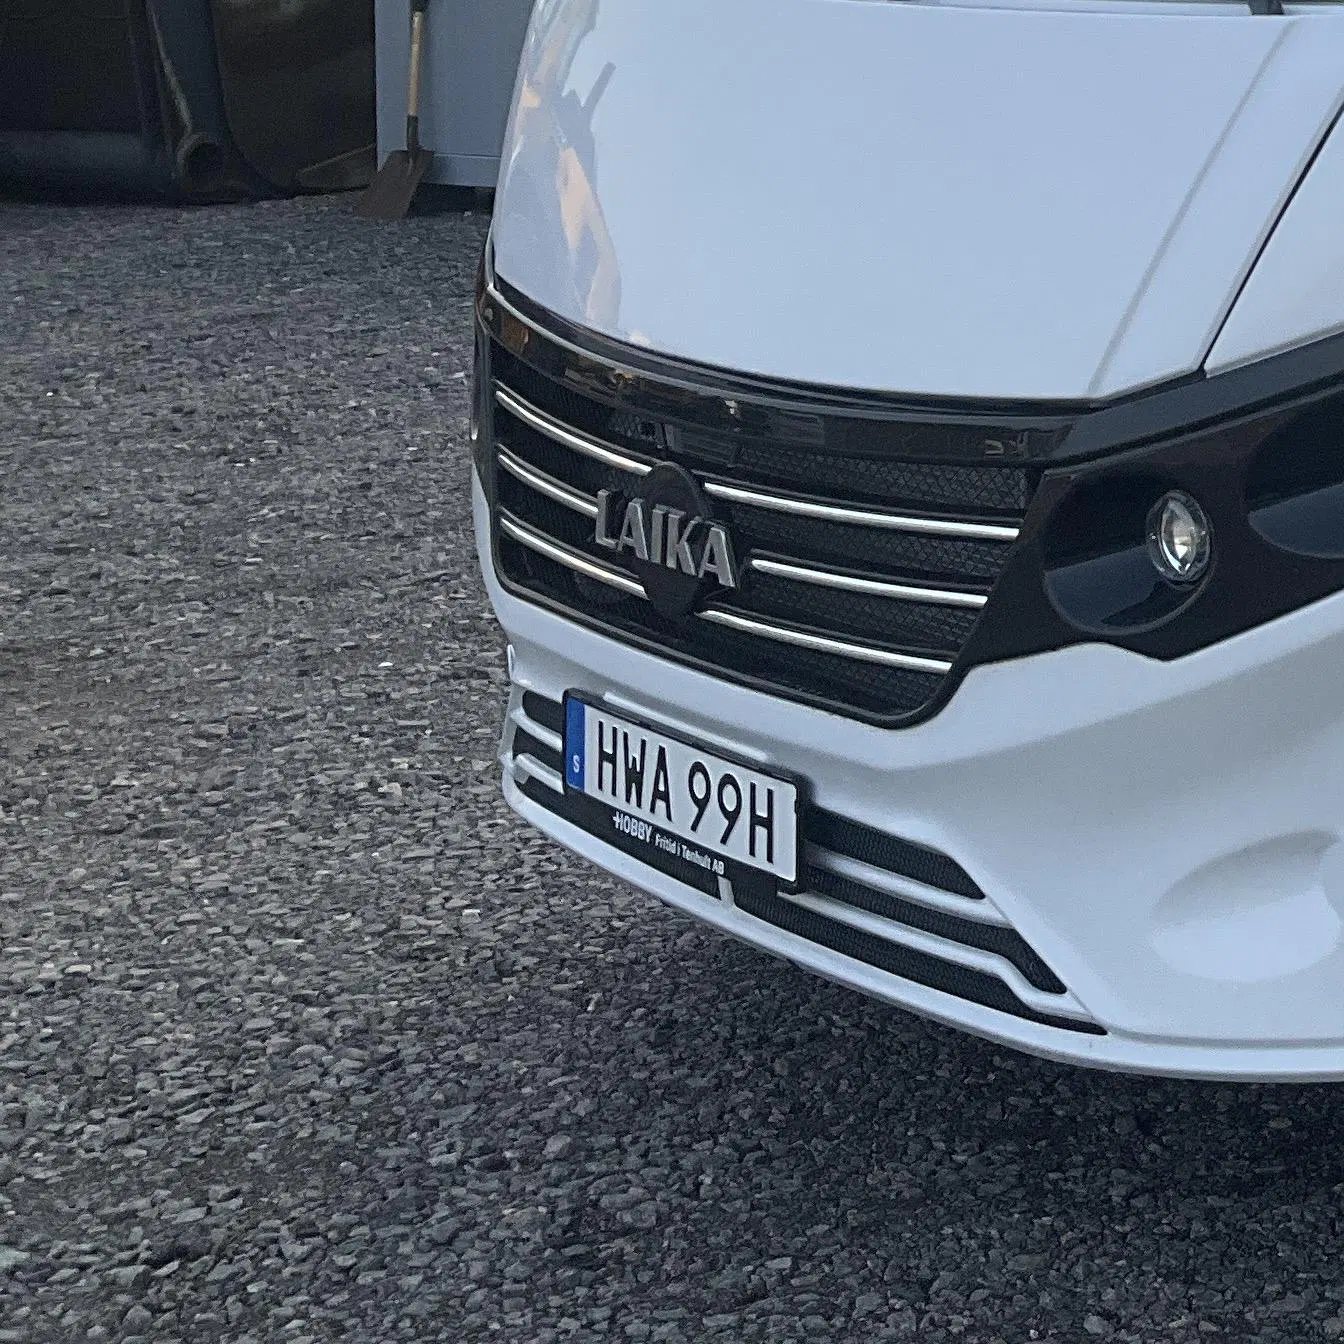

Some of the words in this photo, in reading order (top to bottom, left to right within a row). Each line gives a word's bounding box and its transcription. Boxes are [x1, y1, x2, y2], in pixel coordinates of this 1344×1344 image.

[595, 488, 738, 588] LAIKA
[572, 754, 581, 774] S
[597, 719, 673, 823] HWA
[687, 760, 775, 865] 99H
[612, 810, 653, 843] HOBBY
